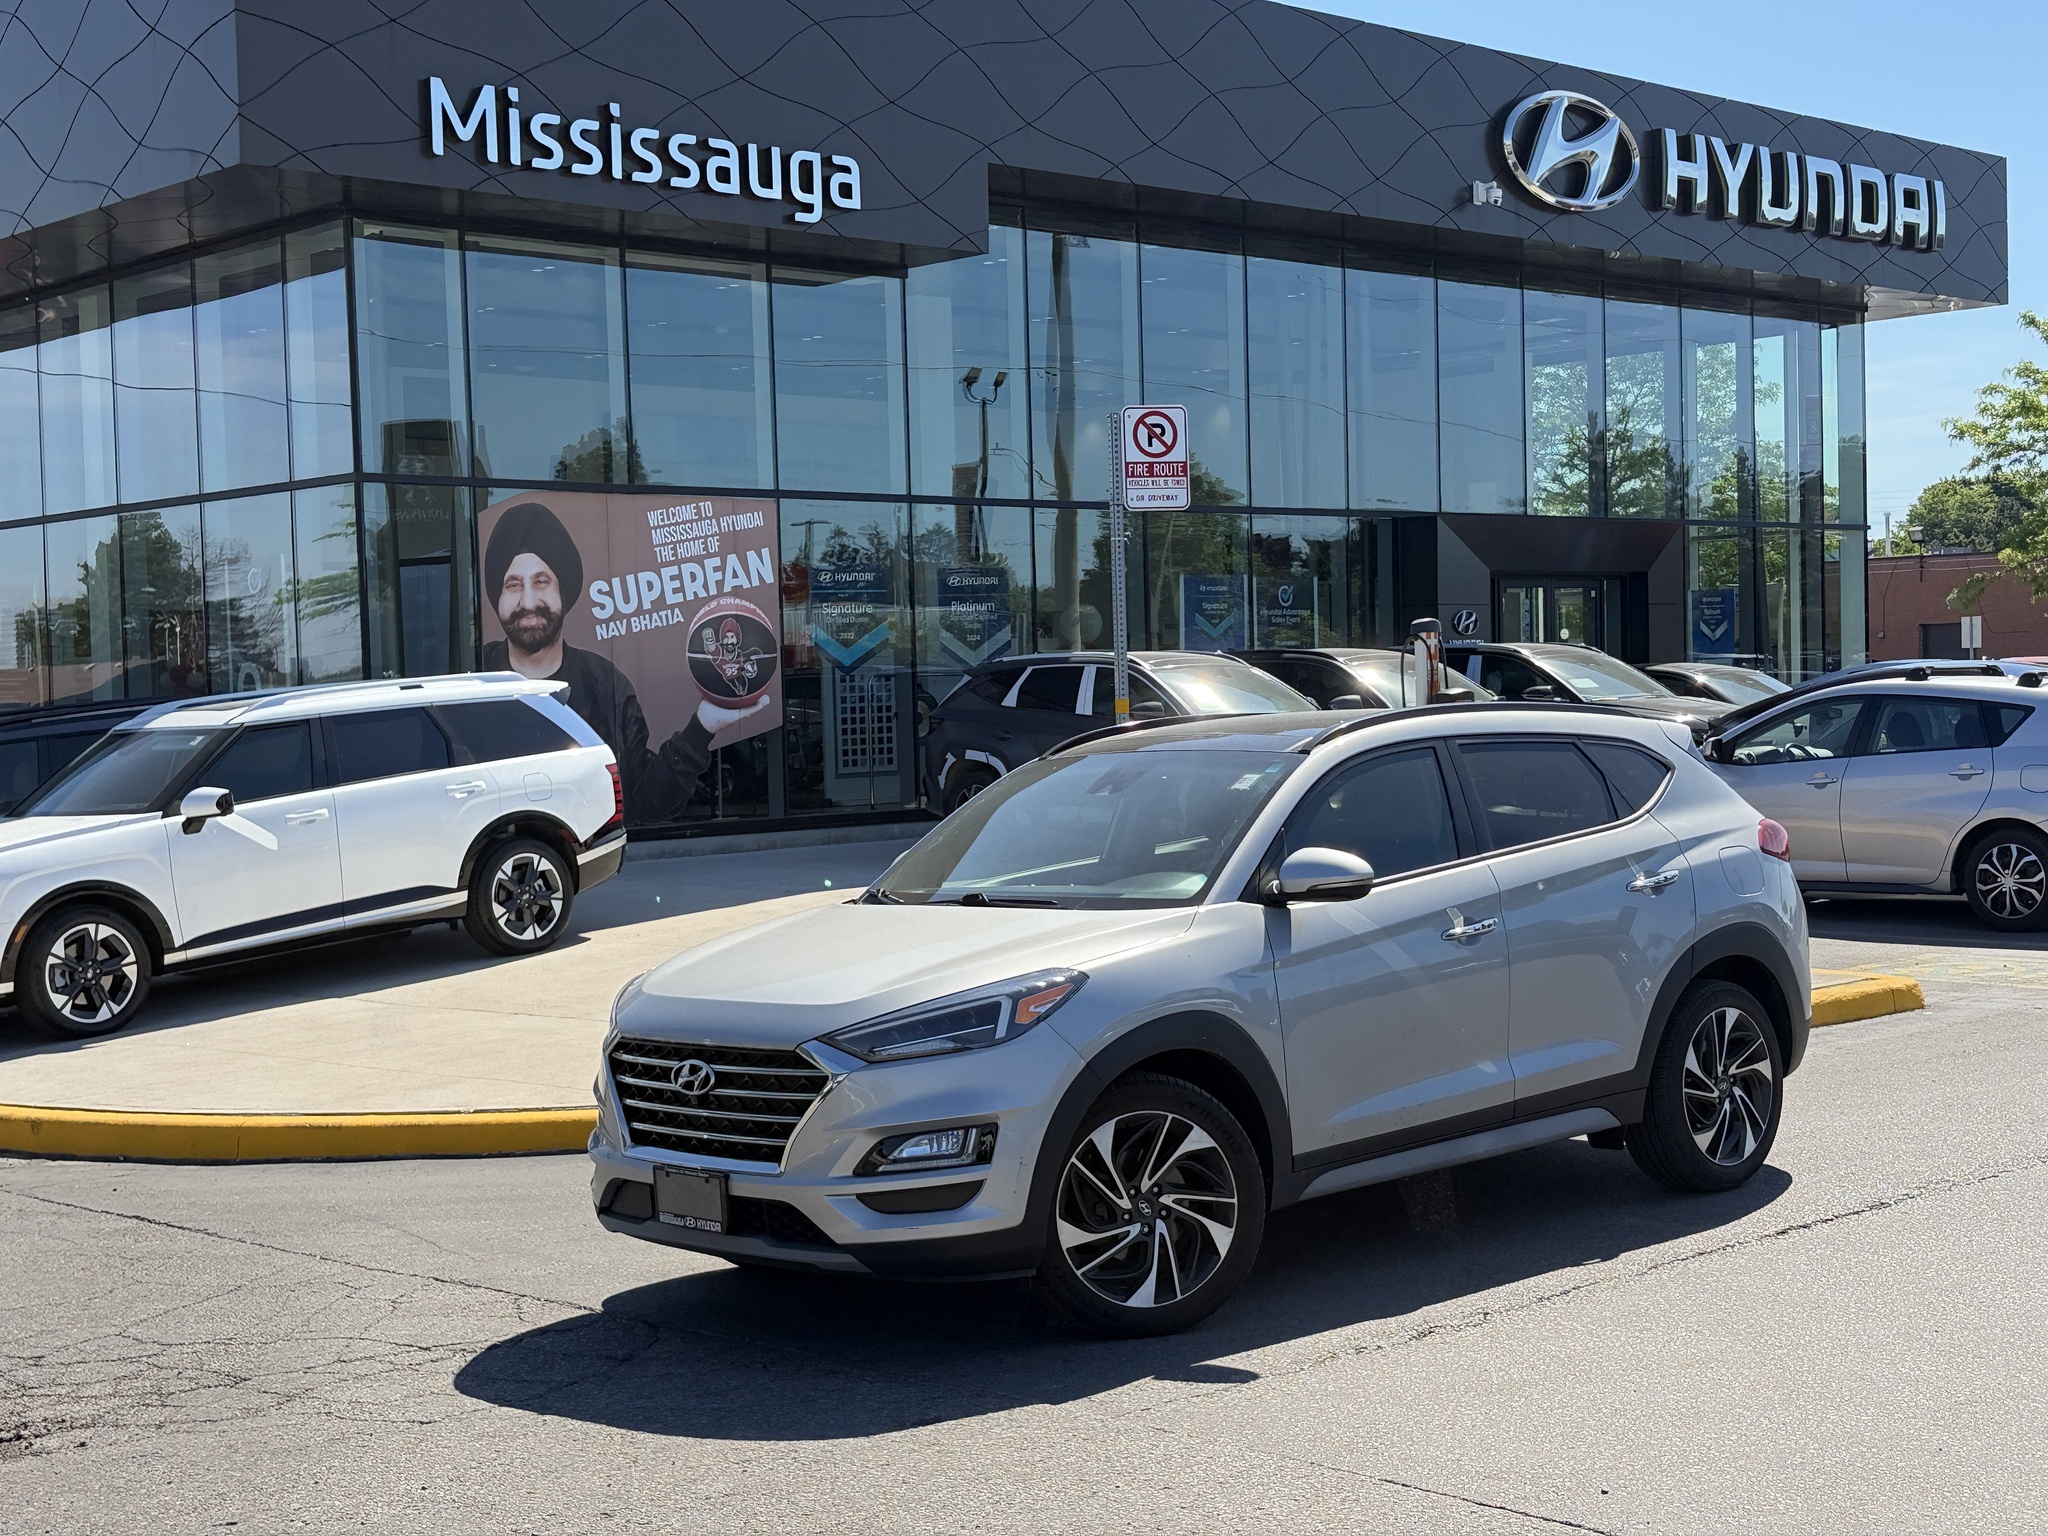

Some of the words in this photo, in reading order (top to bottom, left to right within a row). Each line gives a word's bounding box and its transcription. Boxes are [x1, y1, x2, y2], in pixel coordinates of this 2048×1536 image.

[429, 75, 862, 224] Mississauga
[1660, 127, 1946, 252] HYUNDAI
[1128, 463, 1150, 476] FIRE
[1153, 463, 1184, 476] ROUTE
[647, 503, 699, 527] WELCOME
[699, 501, 713, 518] TO
[651, 518, 720, 545] MISSISSAUGA
[720, 511, 764, 533] HYUNDAI
[654, 544, 676, 563] THE
[676, 538, 707, 559] HOME
[707, 535, 720, 553] OF
[588, 547, 775, 620] SUPERFAN
[834, 572, 875, 583] HYUNDAI
[962, 576, 999, 585] HYUNDAI
[821, 602, 873, 616] Signature
[951, 600, 995, 612] Platinum
[595, 618, 627, 641] NAV
[631, 607, 685, 633] BHATIA
